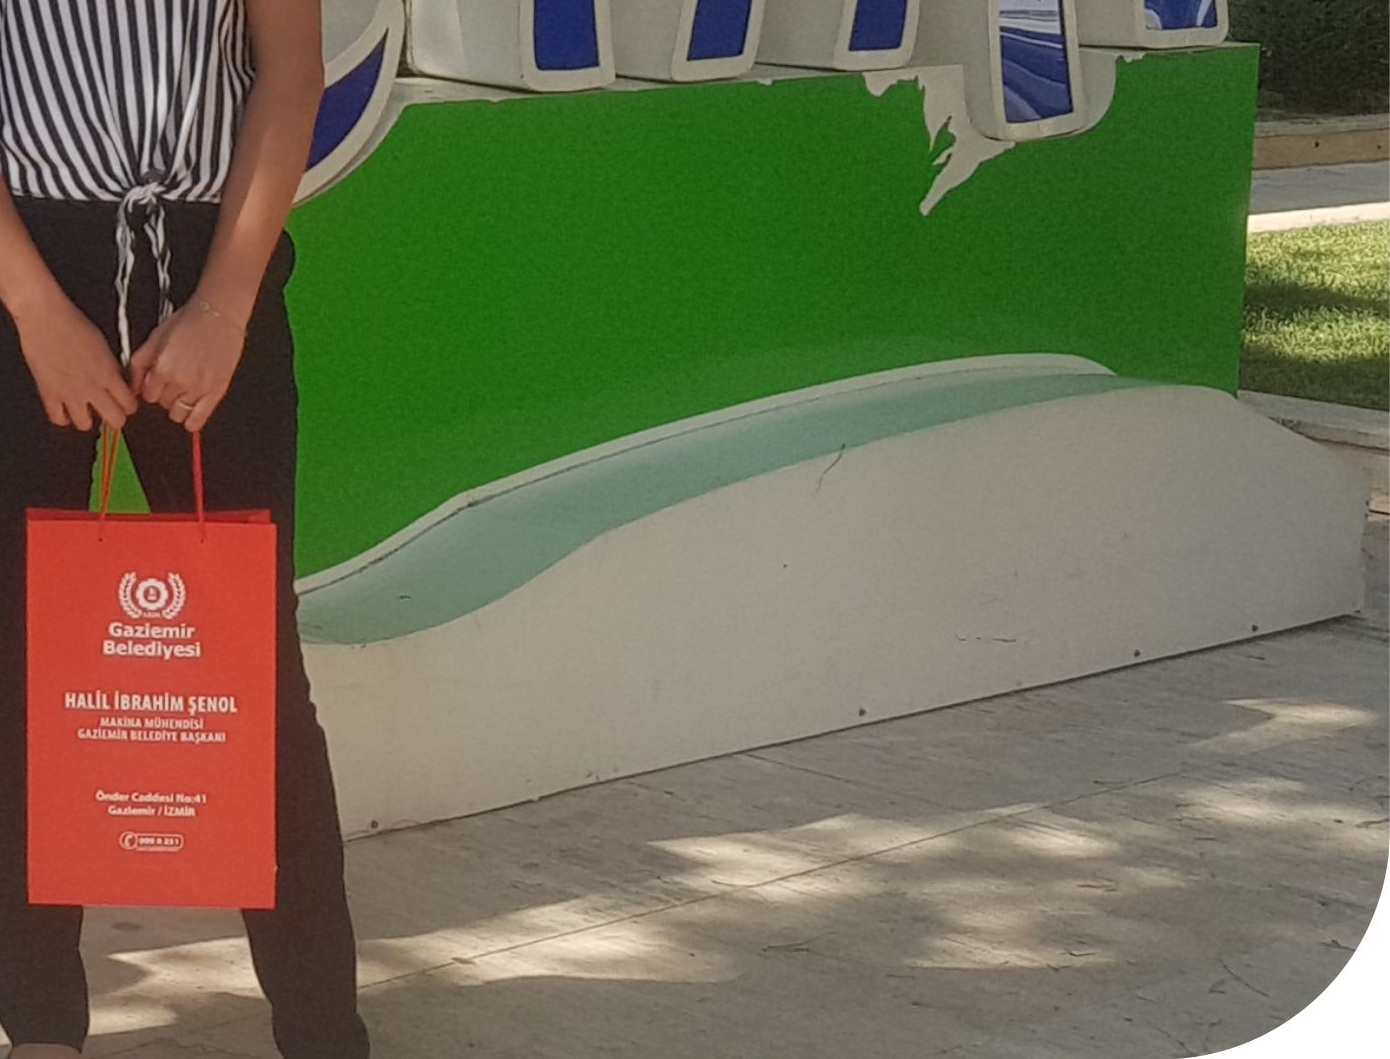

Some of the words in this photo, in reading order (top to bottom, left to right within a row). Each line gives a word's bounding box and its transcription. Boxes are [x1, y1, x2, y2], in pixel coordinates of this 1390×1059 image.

[108, 622, 195, 639] Gaziemir
[103, 639, 201, 660] Belediyesi
[65, 689, 111, 709] HALİL
[114, 690, 184, 712] İBRAHİM
[188, 696, 238, 716] ŞENOL
[100, 717, 142, 729] MAKİNA
[144, 717, 204, 730] MÜHENDİSİ
[78, 727, 128, 740] GAZİEMİR
[130, 730, 177, 742] BELEDİYE
[181, 731, 226, 744] BAŞKANI
[108, 805, 155, 816] Gaziemir
